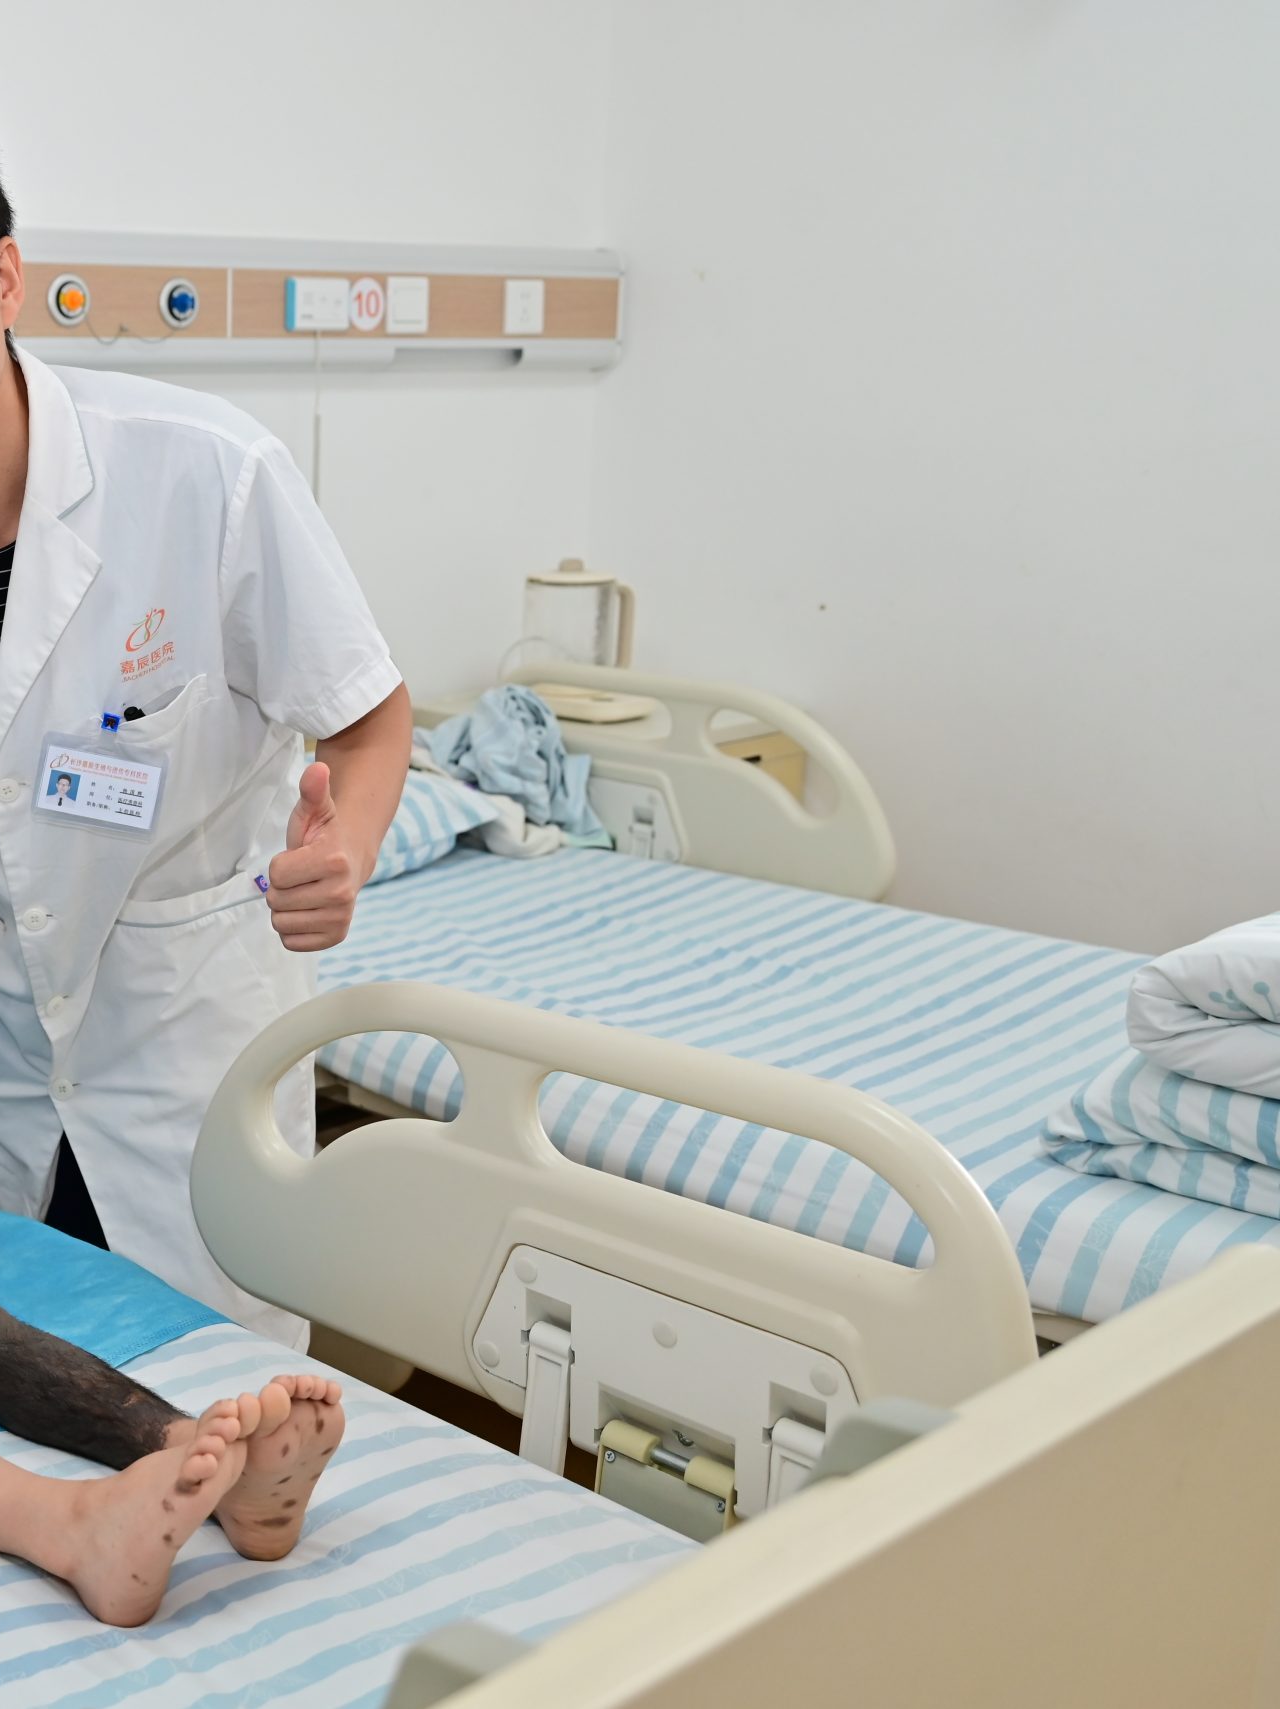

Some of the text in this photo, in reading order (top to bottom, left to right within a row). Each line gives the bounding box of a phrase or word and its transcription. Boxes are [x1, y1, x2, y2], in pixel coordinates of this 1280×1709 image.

[353, 289, 381, 319] 10
[120, 641, 174, 675] 嘉辰医院
